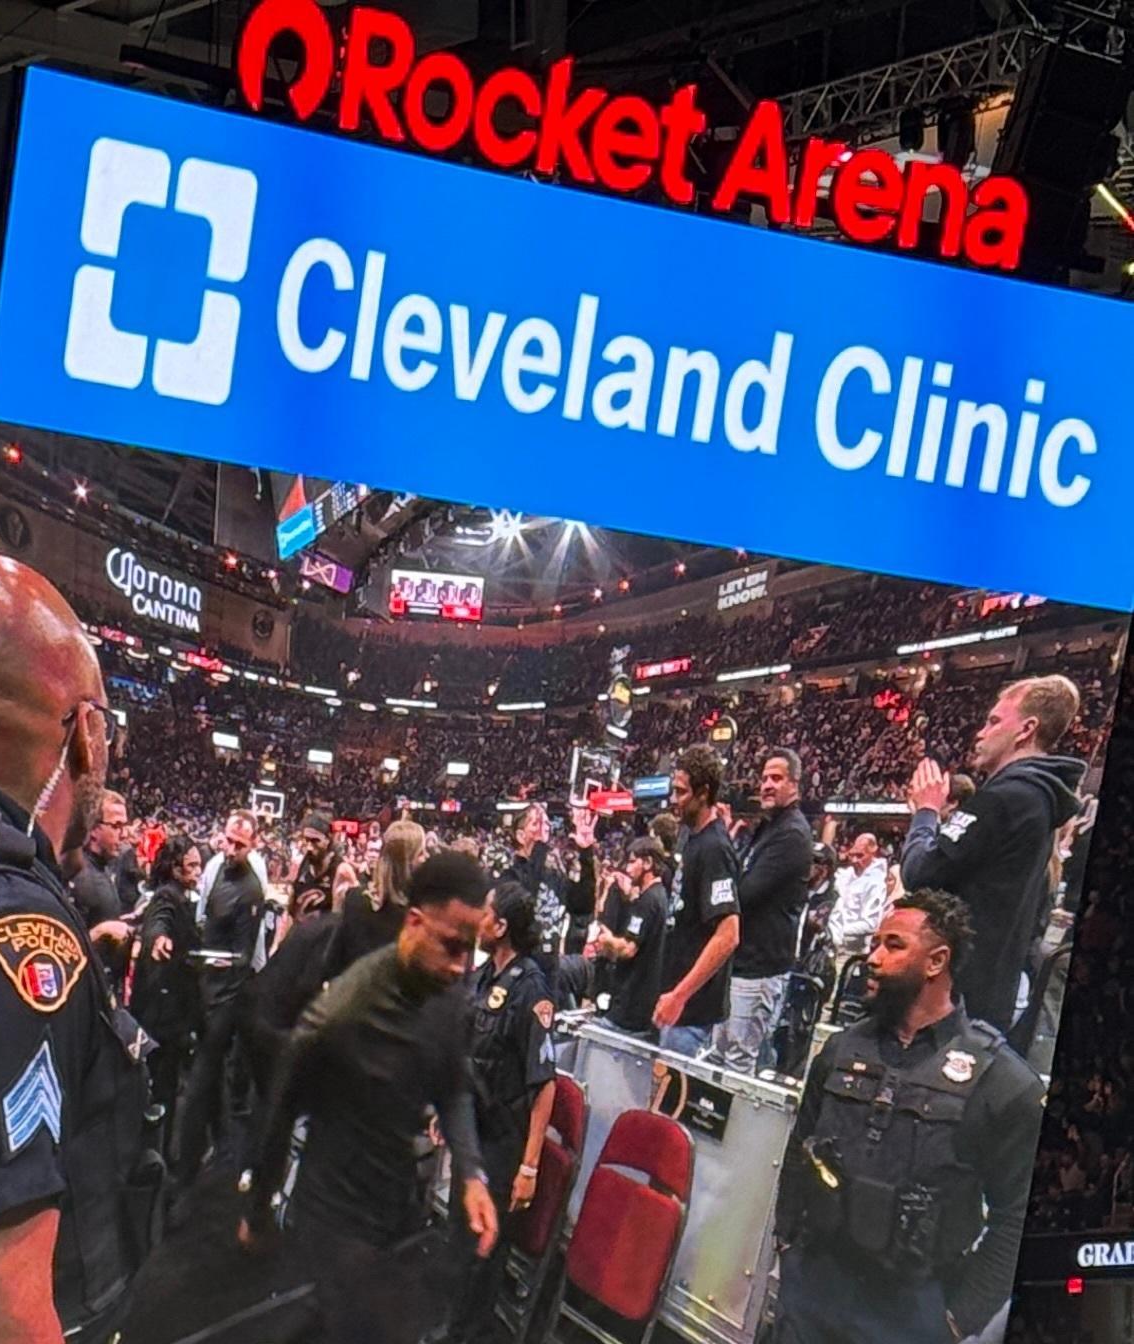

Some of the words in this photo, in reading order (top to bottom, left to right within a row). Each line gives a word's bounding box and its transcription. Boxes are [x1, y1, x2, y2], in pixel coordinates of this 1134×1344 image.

[338, 7, 704, 203] Rocket
[712, 102, 1029, 269] Arena
[276, 239, 794, 456] Cleveland
[815, 346, 1098, 507] Clinic
[106, 547, 202, 612] Corona
[718, 579, 745, 595] LET
[132, 594, 200, 633] CANTINA
